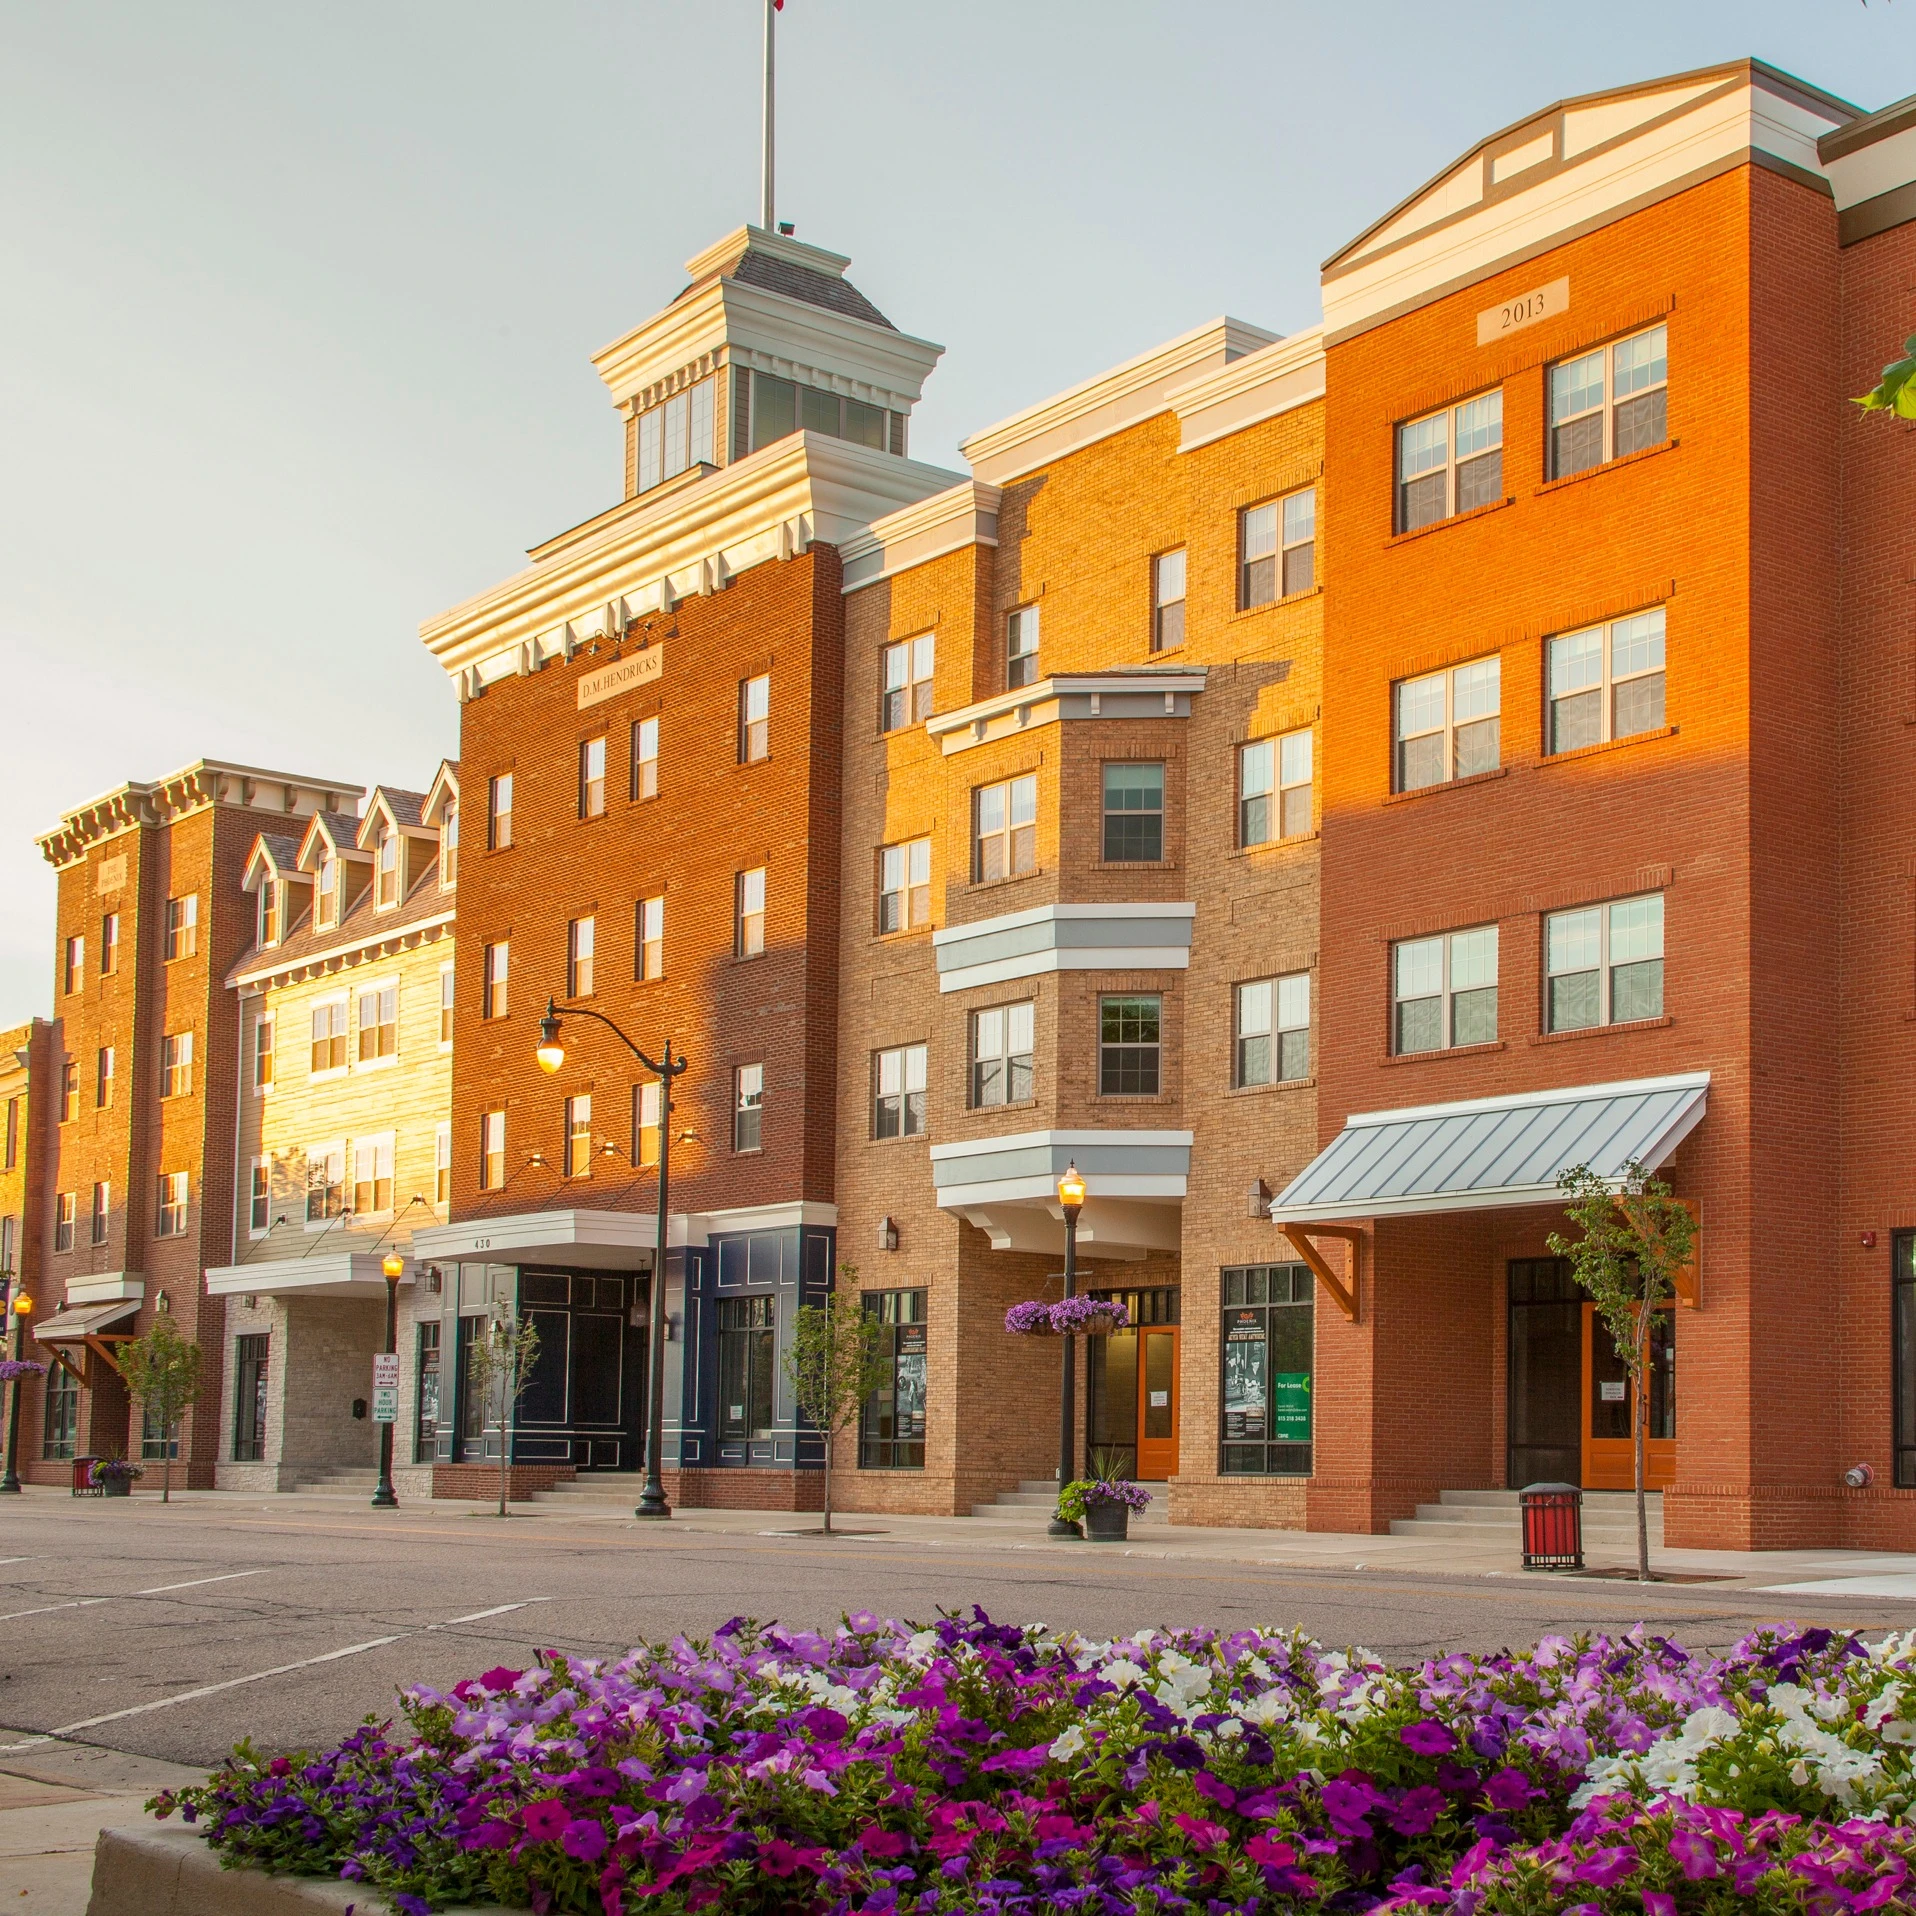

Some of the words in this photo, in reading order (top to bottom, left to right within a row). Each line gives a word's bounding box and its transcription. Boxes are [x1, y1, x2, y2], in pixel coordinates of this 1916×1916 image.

[1501, 293, 1545, 329] 2013
[101, 872, 123, 888] PHOENIX
[474, 1238, 491, 1249] 430
